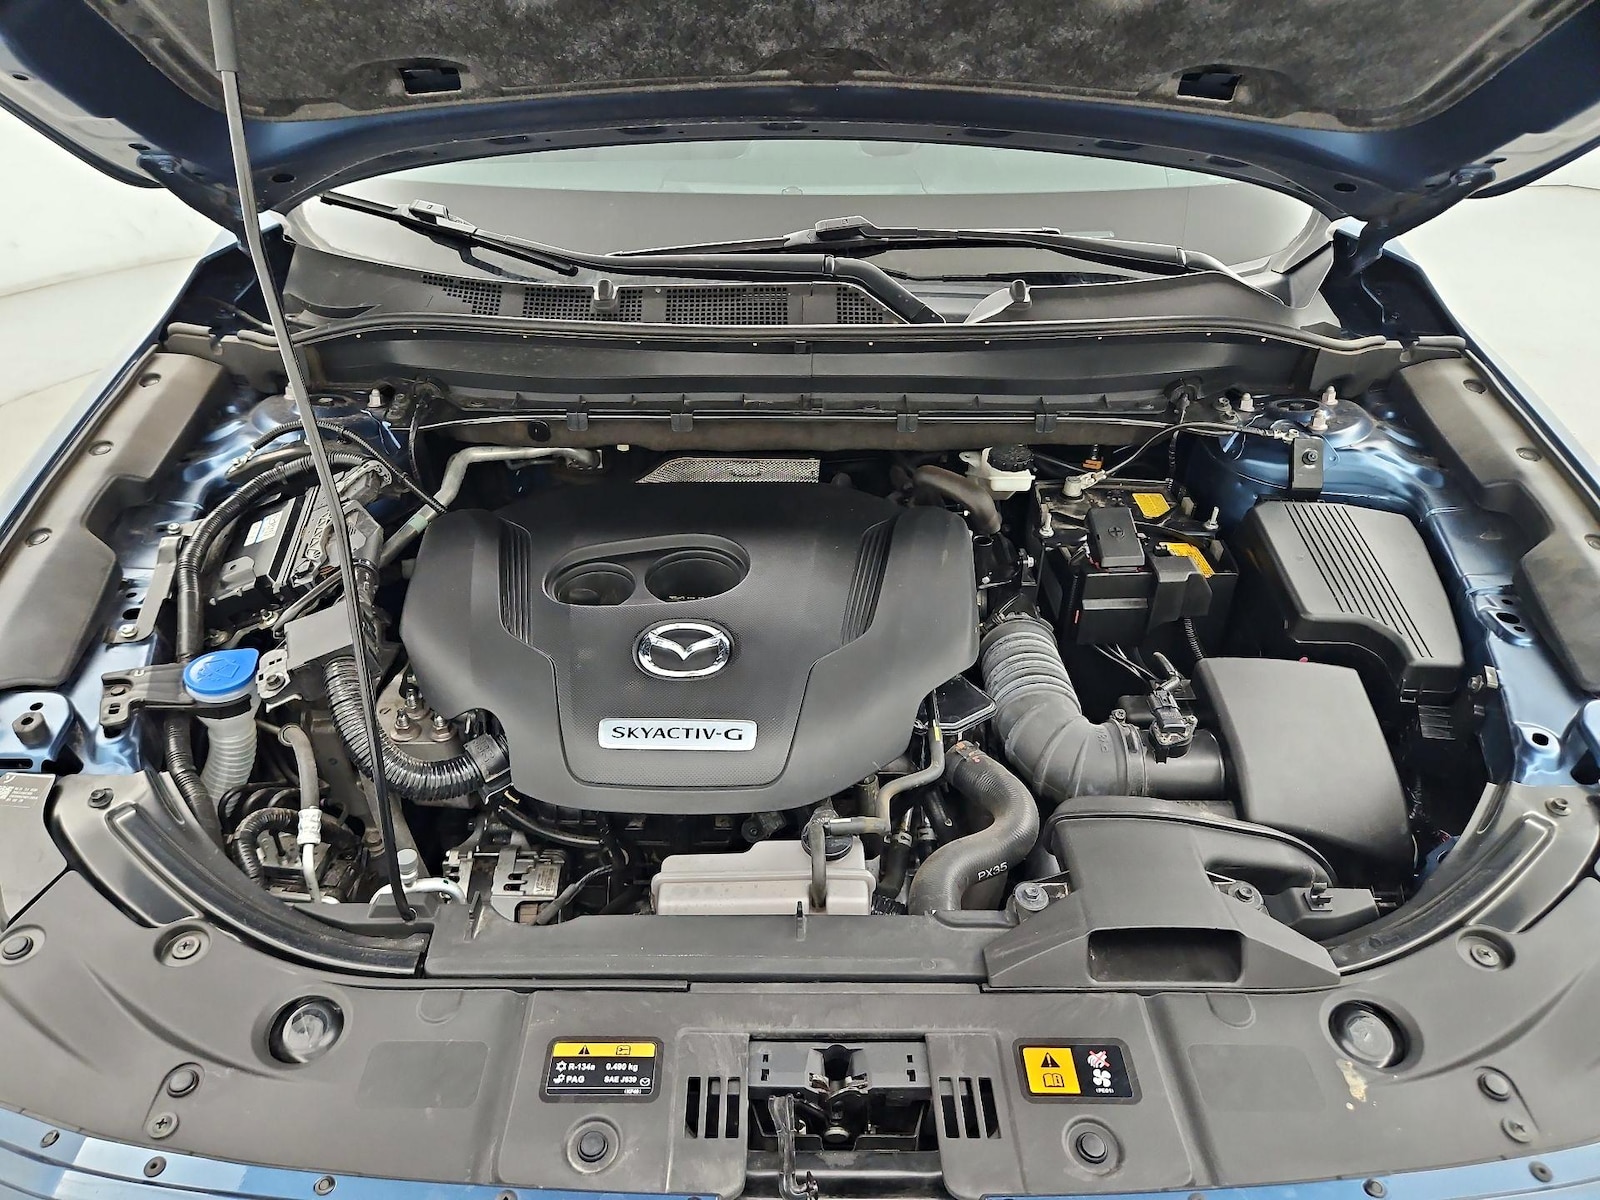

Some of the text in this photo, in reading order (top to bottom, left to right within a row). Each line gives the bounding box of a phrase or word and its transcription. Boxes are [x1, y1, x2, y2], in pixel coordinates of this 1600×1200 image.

[611, 726, 743, 741] SKYACTIV-G
[977, 861, 1008, 881] PX35
[568, 1062, 596, 1071] R-134a
[628, 1062, 639, 1072] kg
[566, 1075, 638, 1084] PAG SAE J639
